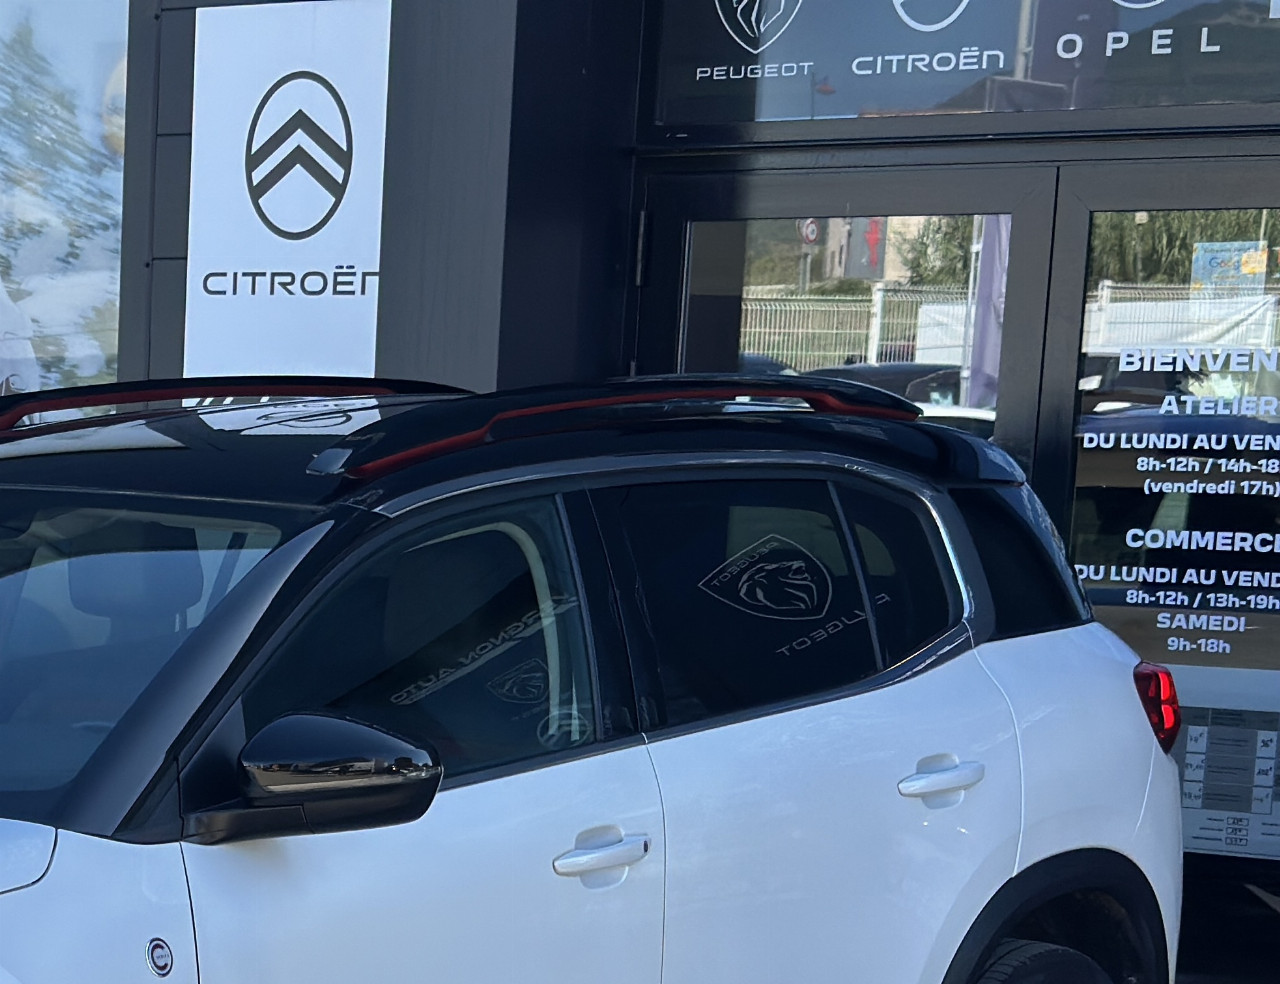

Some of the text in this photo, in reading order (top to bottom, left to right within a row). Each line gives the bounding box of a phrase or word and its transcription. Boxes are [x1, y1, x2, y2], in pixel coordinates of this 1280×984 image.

[1056, 27, 1220, 59] OPEL
[696, 62, 814, 80] PEUGEOT
[851, 47, 1004, 75] CITROËN
[1158, 395, 1277, 416] ATELIER
[1083, 432, 1280, 451] DU LUNDI AU VEN
[1136, 456, 1200, 472] 8h-12h
[1204, 458, 1213, 474] /
[1143, 478, 1280, 498] (vendredi 17h)
[1074, 564, 1105, 581] DU
[1109, 565, 1178, 583] LUNDI
[1182, 568, 1216, 585] AU
[1125, 589, 1280, 610] 8h-12h / 13h-19h
[1156, 612, 1246, 632] SAMEDI
[1167, 636, 1231, 654] 9h-18h
